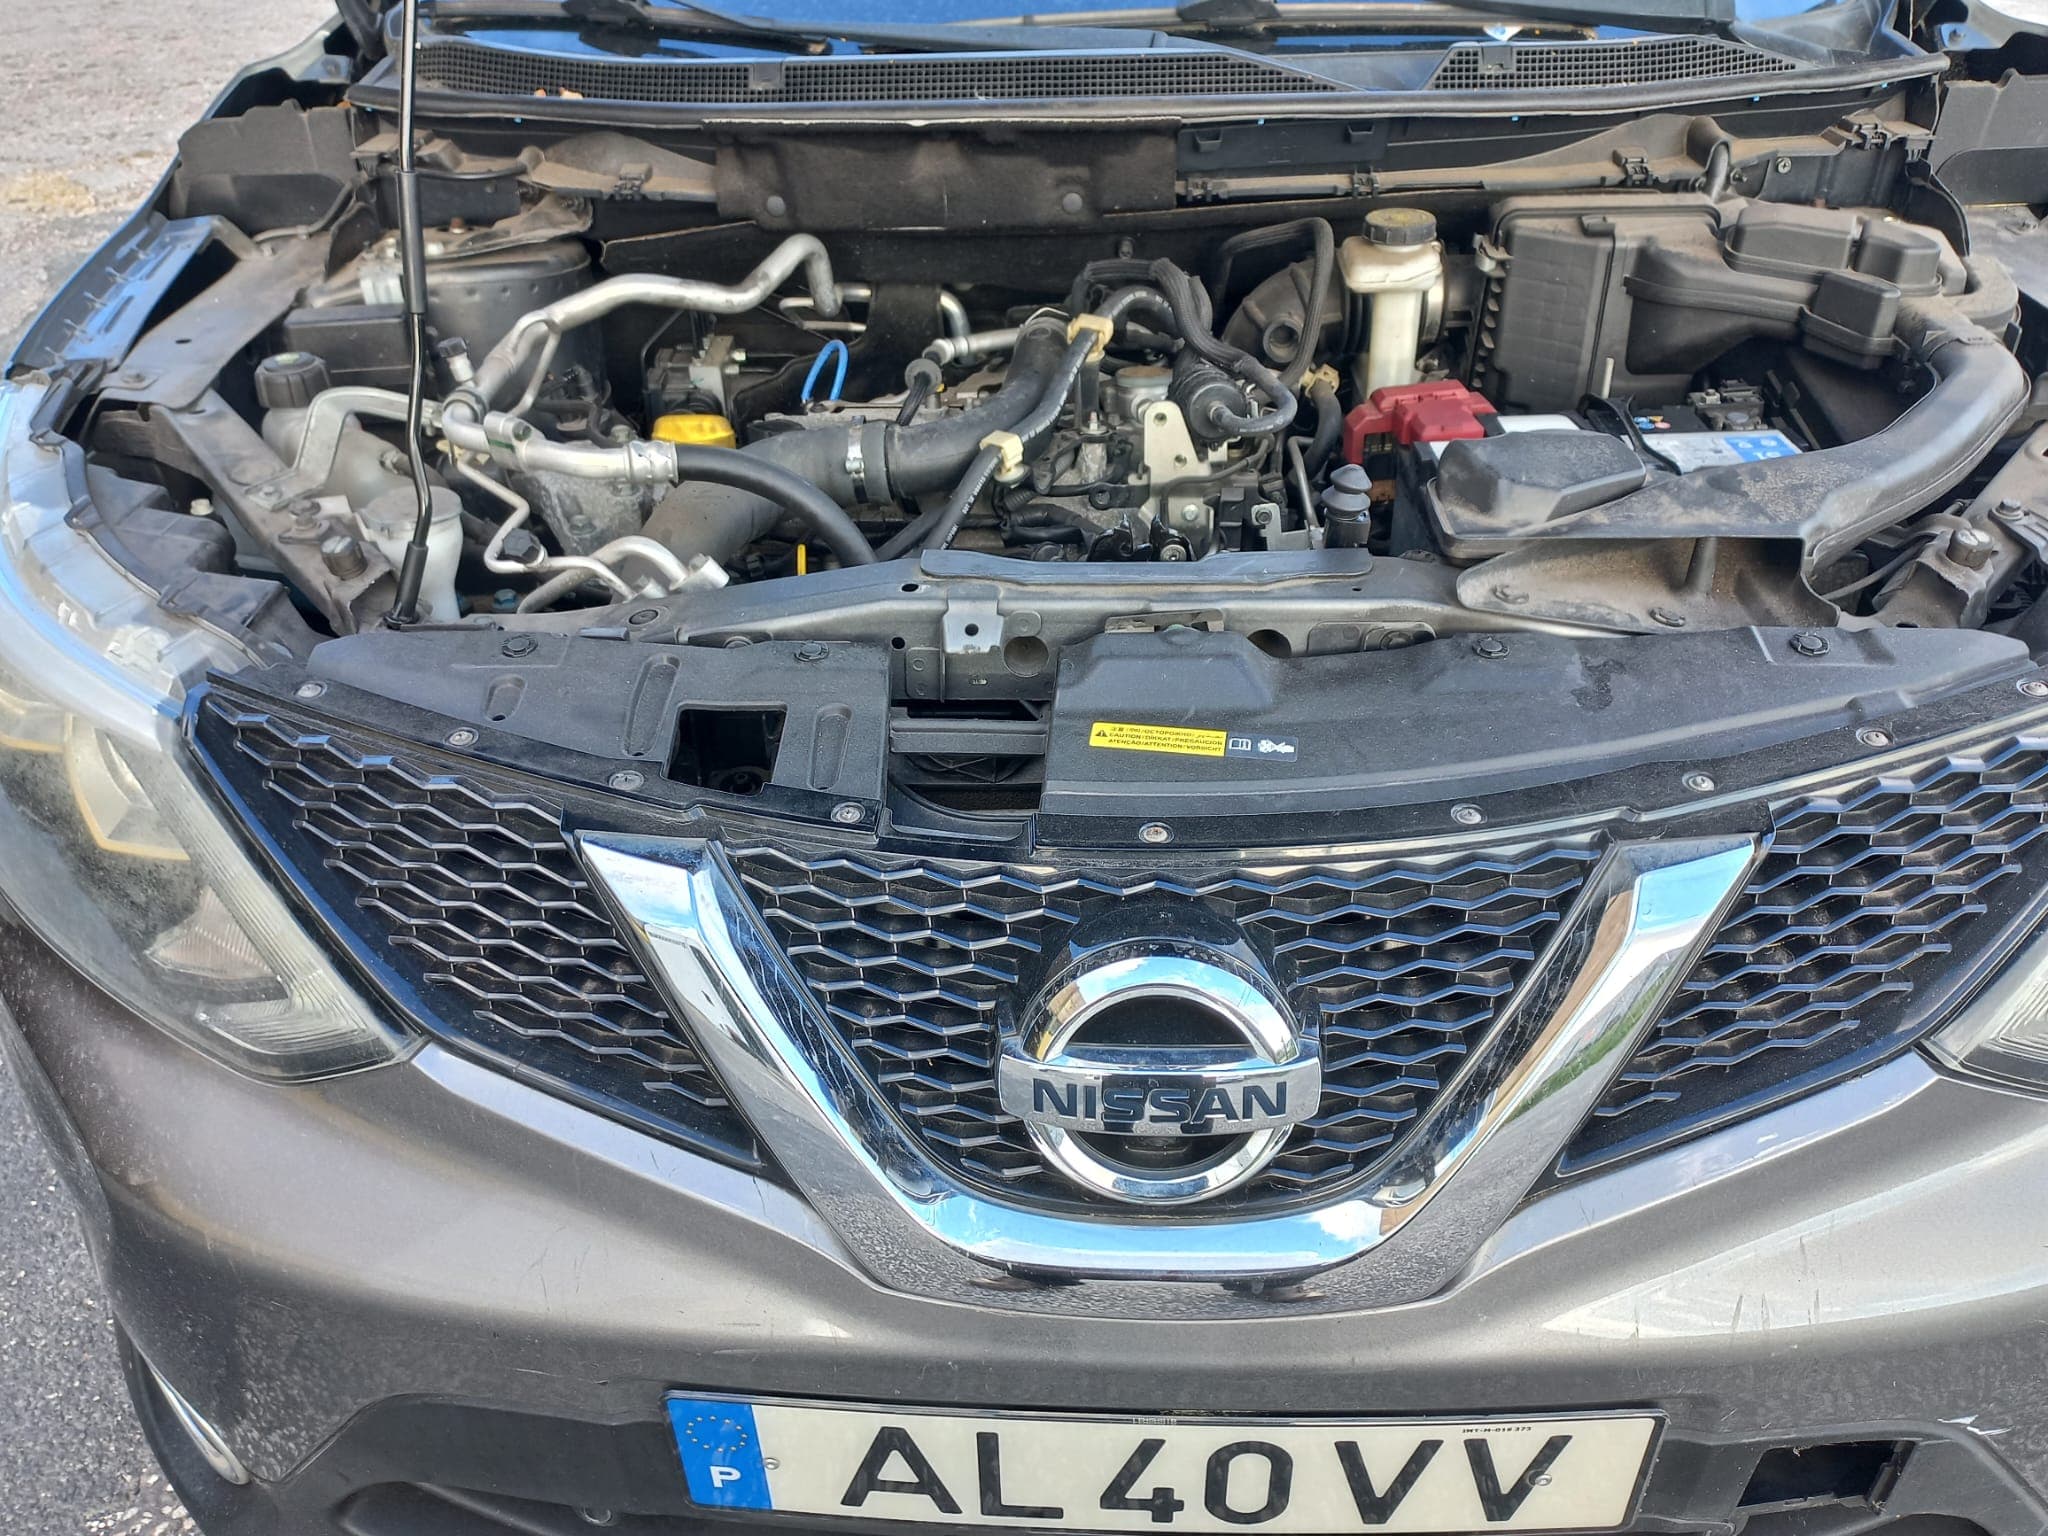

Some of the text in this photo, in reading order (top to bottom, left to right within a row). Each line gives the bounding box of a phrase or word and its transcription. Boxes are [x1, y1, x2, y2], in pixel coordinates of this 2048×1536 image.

[1032, 1078, 1287, 1124] NISSAN
[710, 1465, 741, 1488] P
[840, 1426, 1573, 1525] AL 40 VV
